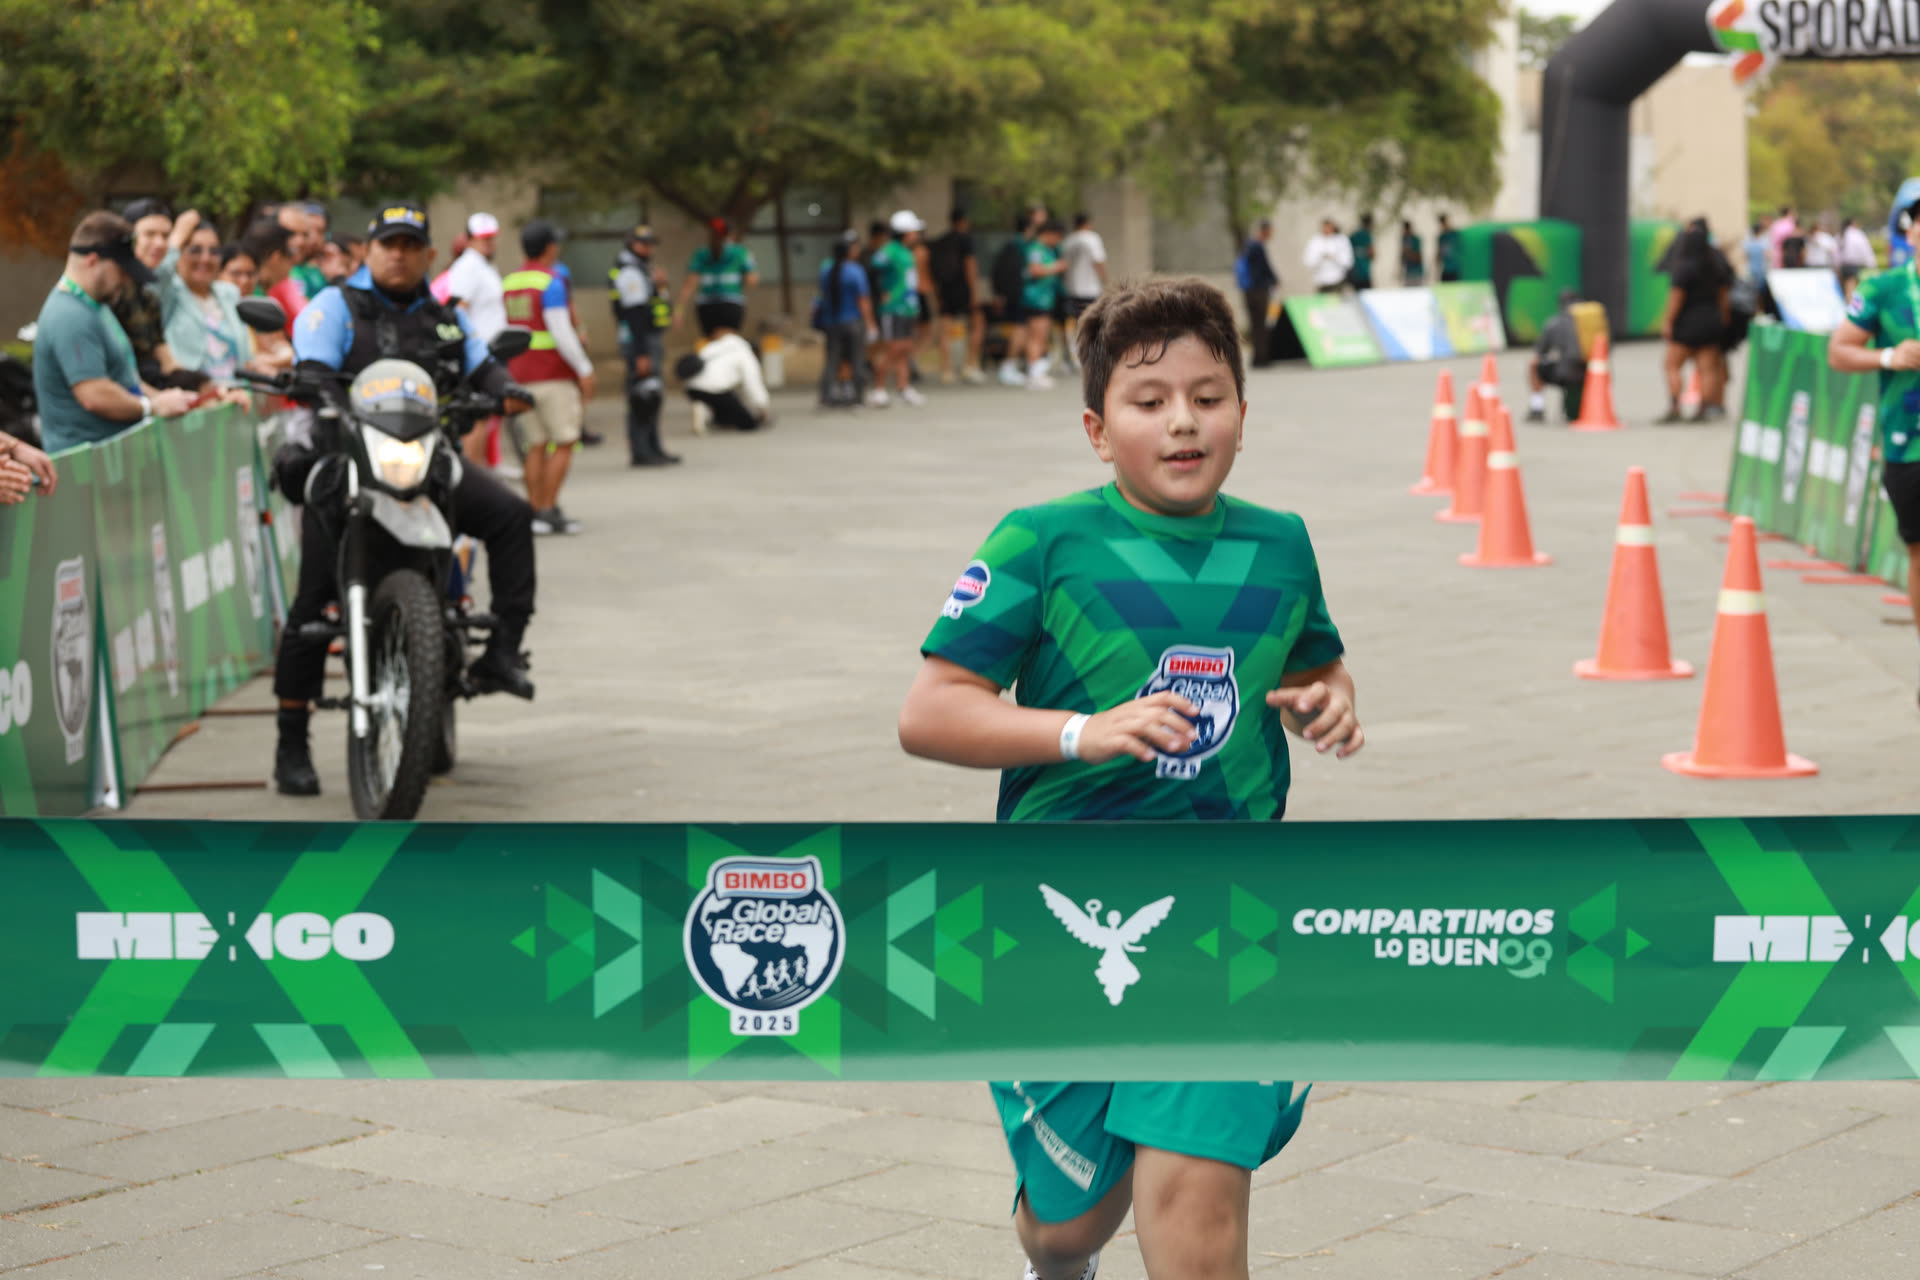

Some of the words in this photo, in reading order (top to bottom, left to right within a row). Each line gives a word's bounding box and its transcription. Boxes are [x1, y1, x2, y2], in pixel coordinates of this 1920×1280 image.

[724, 872, 807, 889] BIMBO
[732, 899, 822, 924] Global
[1292, 908, 1555, 935] COMPARTIMOS
[711, 918, 785, 943] Race
[1374, 938, 1404, 958] LO
[738, 1015, 793, 1031] 2025
